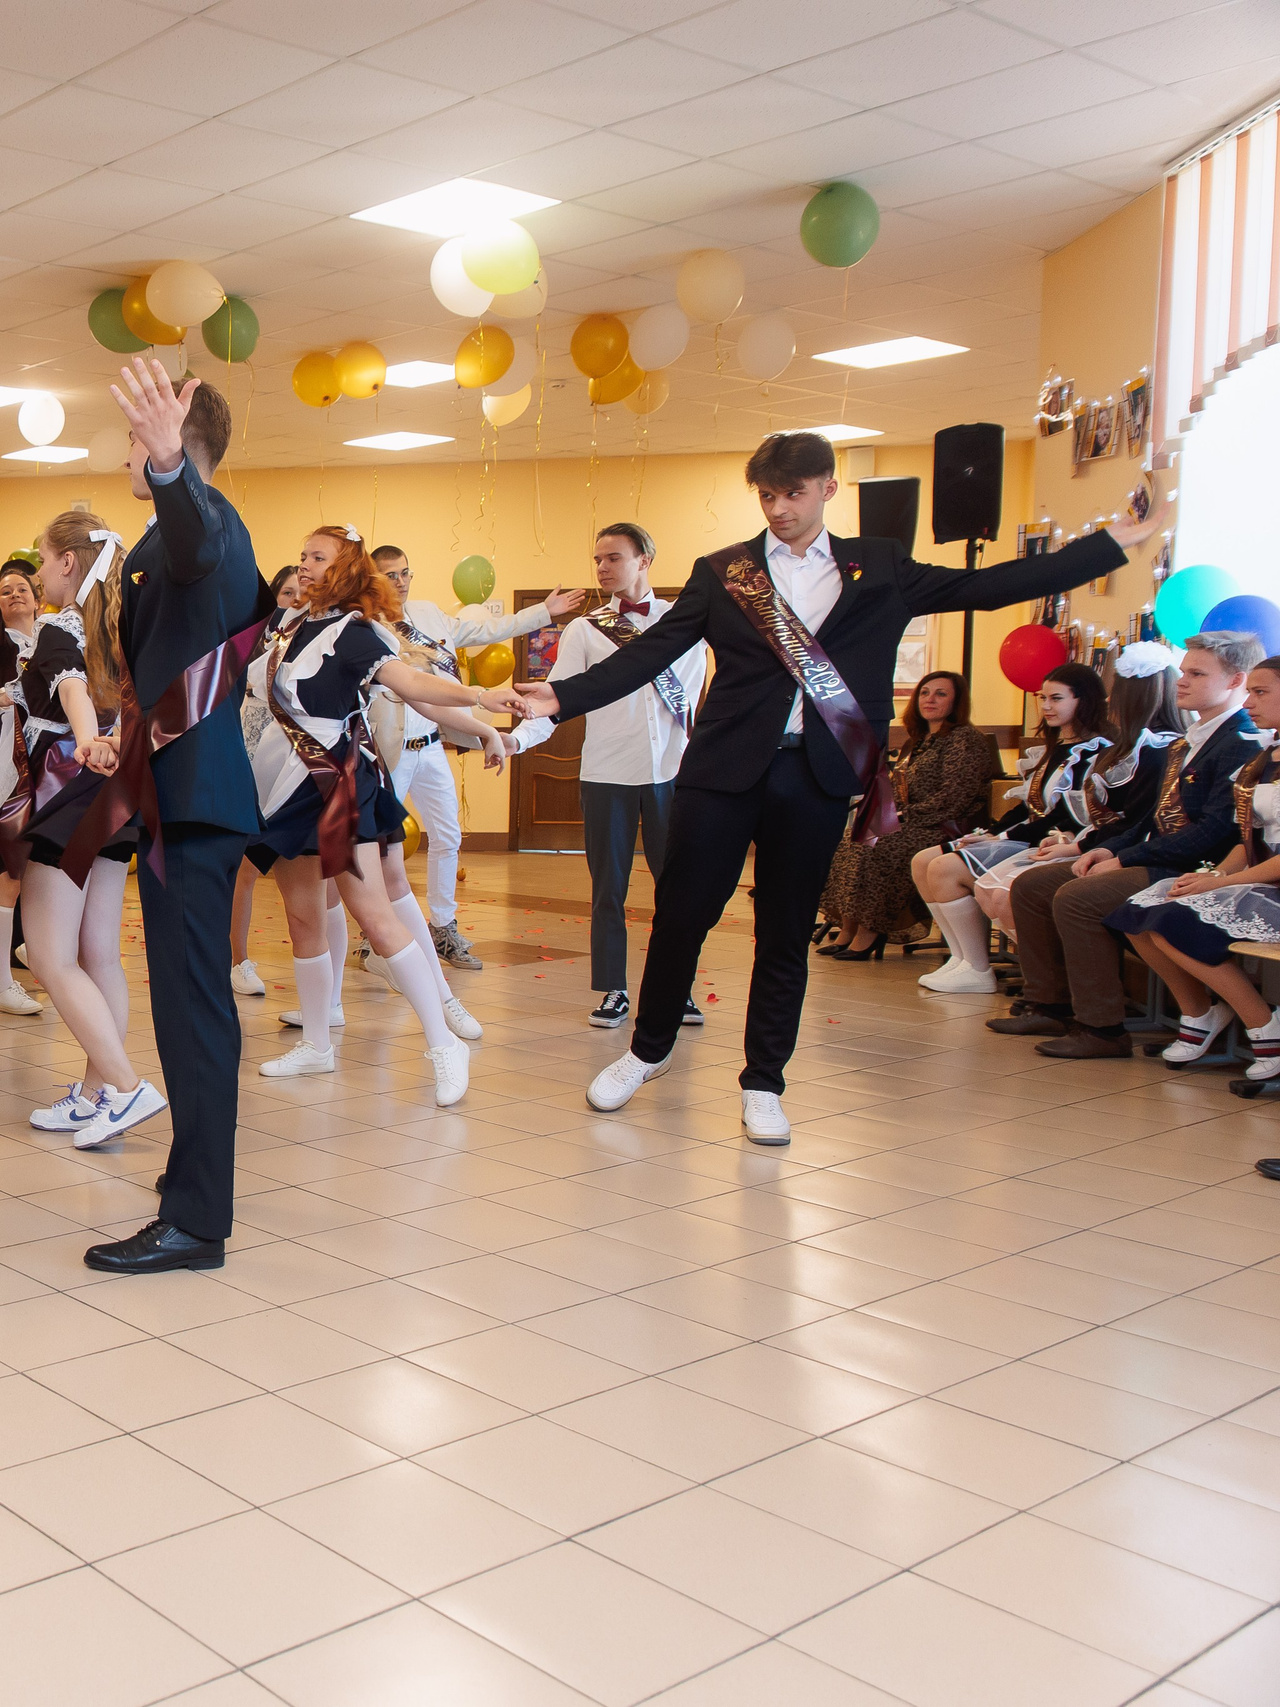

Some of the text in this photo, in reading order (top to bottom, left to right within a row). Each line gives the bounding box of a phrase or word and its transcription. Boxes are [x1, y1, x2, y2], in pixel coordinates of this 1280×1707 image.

[740, 573, 846, 699] Выпускник 2024
[664, 686, 690, 713] 2024
